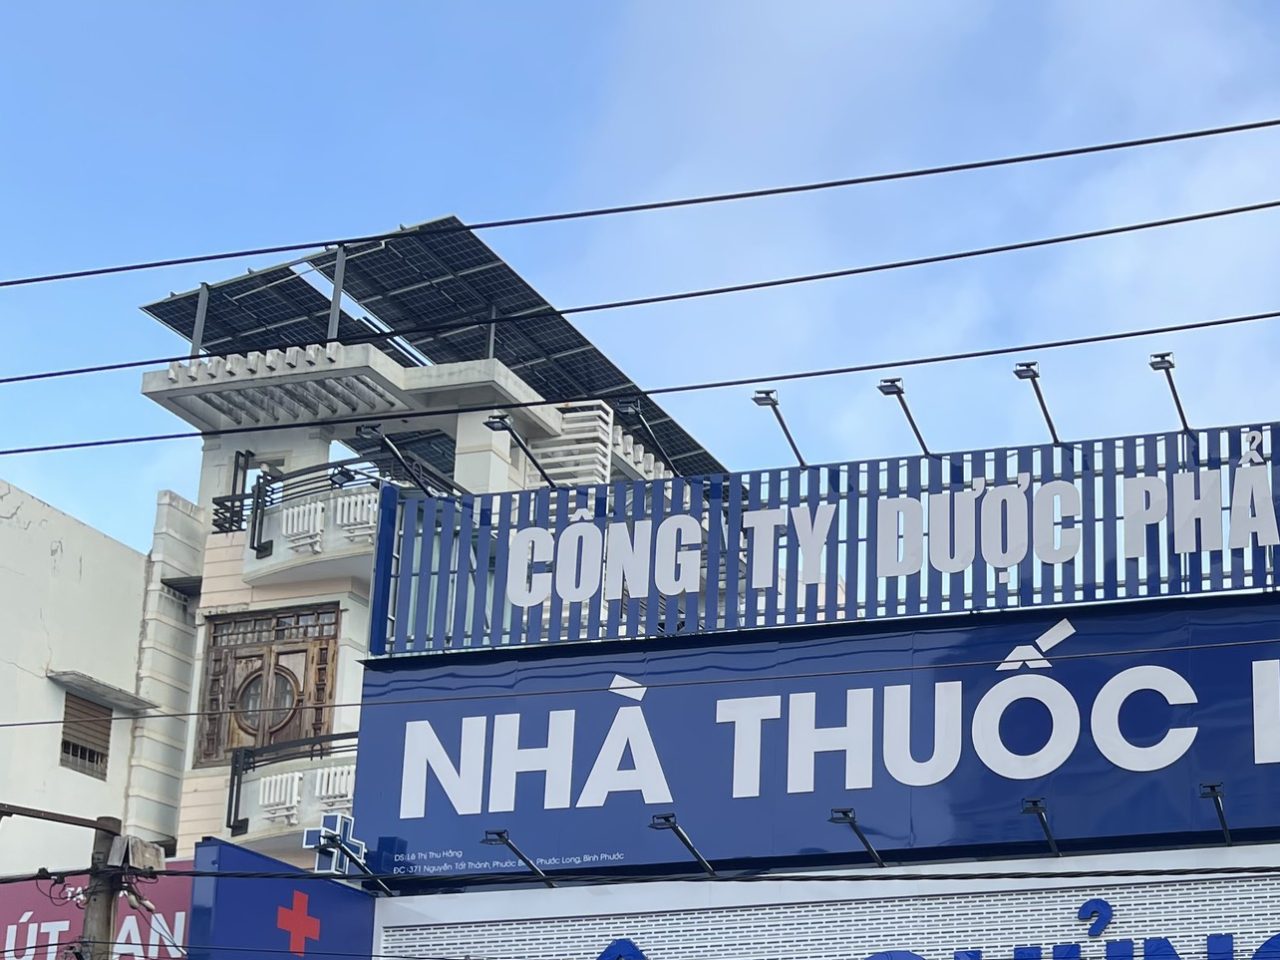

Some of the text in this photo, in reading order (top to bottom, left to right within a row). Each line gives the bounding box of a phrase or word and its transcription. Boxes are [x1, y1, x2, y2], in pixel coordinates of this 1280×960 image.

[506, 510, 702, 608] CÔNG
[743, 502, 838, 589] TY
[877, 471, 1083, 584] DƯỢC
[398, 673, 674, 819] NHÀ
[715, 617, 1199, 798] THUỐC
